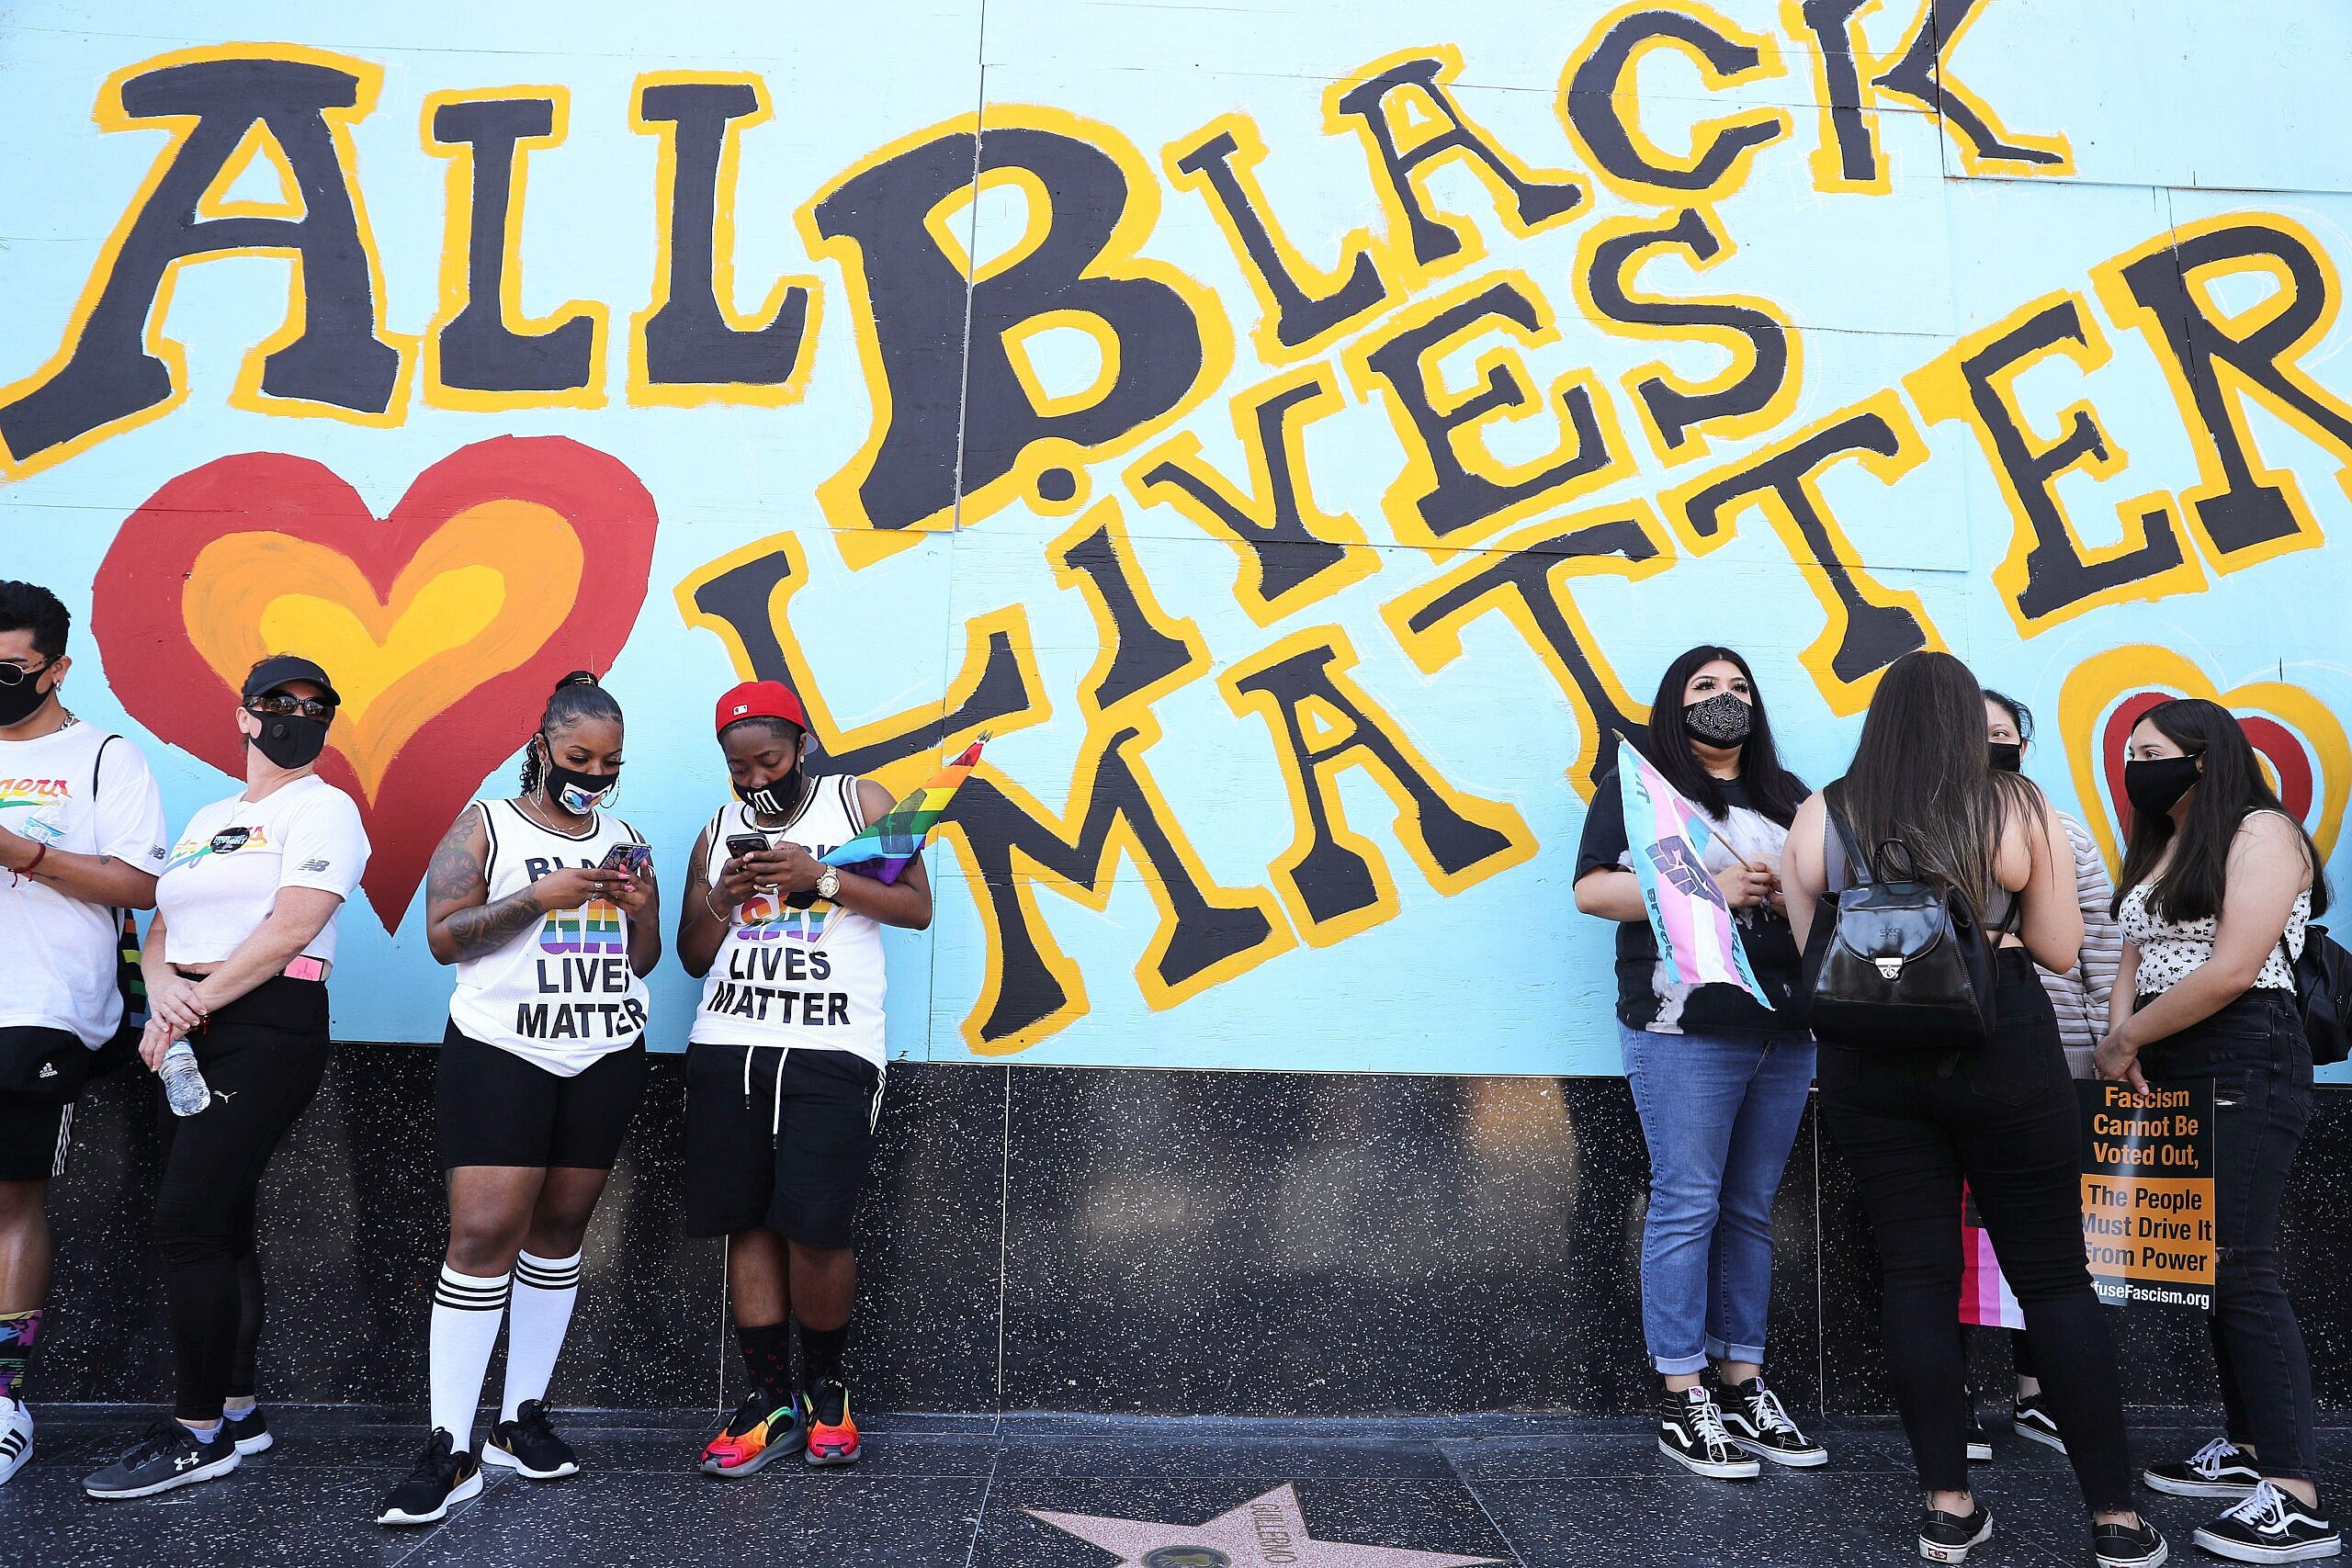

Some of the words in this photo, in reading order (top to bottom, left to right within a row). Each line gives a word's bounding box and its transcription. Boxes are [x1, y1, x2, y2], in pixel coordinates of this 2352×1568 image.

[0, 51, 818, 468] ALL
[807, 0, 2069, 537] BLACK
[944, 220, 2352, 1047] MATTER
[729, 947, 831, 981] LIVES
[516, 998, 648, 1039] MATTER
[707, 980, 851, 1026] MATTER
[2105, 1086, 2190, 1109] Fascism
[2093, 1113, 2170, 1137] Cannot
[2175, 1115, 2199, 1137] Be
[2092, 1142, 2154, 1166] Voted
[2161, 1145, 2199, 1169] Out,
[2087, 1184, 2129, 1207] The
[2134, 1187, 2202, 1214] People
[2082, 1213, 2132, 1237] Must
[2139, 1216, 2191, 1240] Drive
[2198, 1219, 2212, 1242] It
[2142, 1246, 2208, 1272] Power
[1250, 1503, 1298, 1563] GUILLERMO
